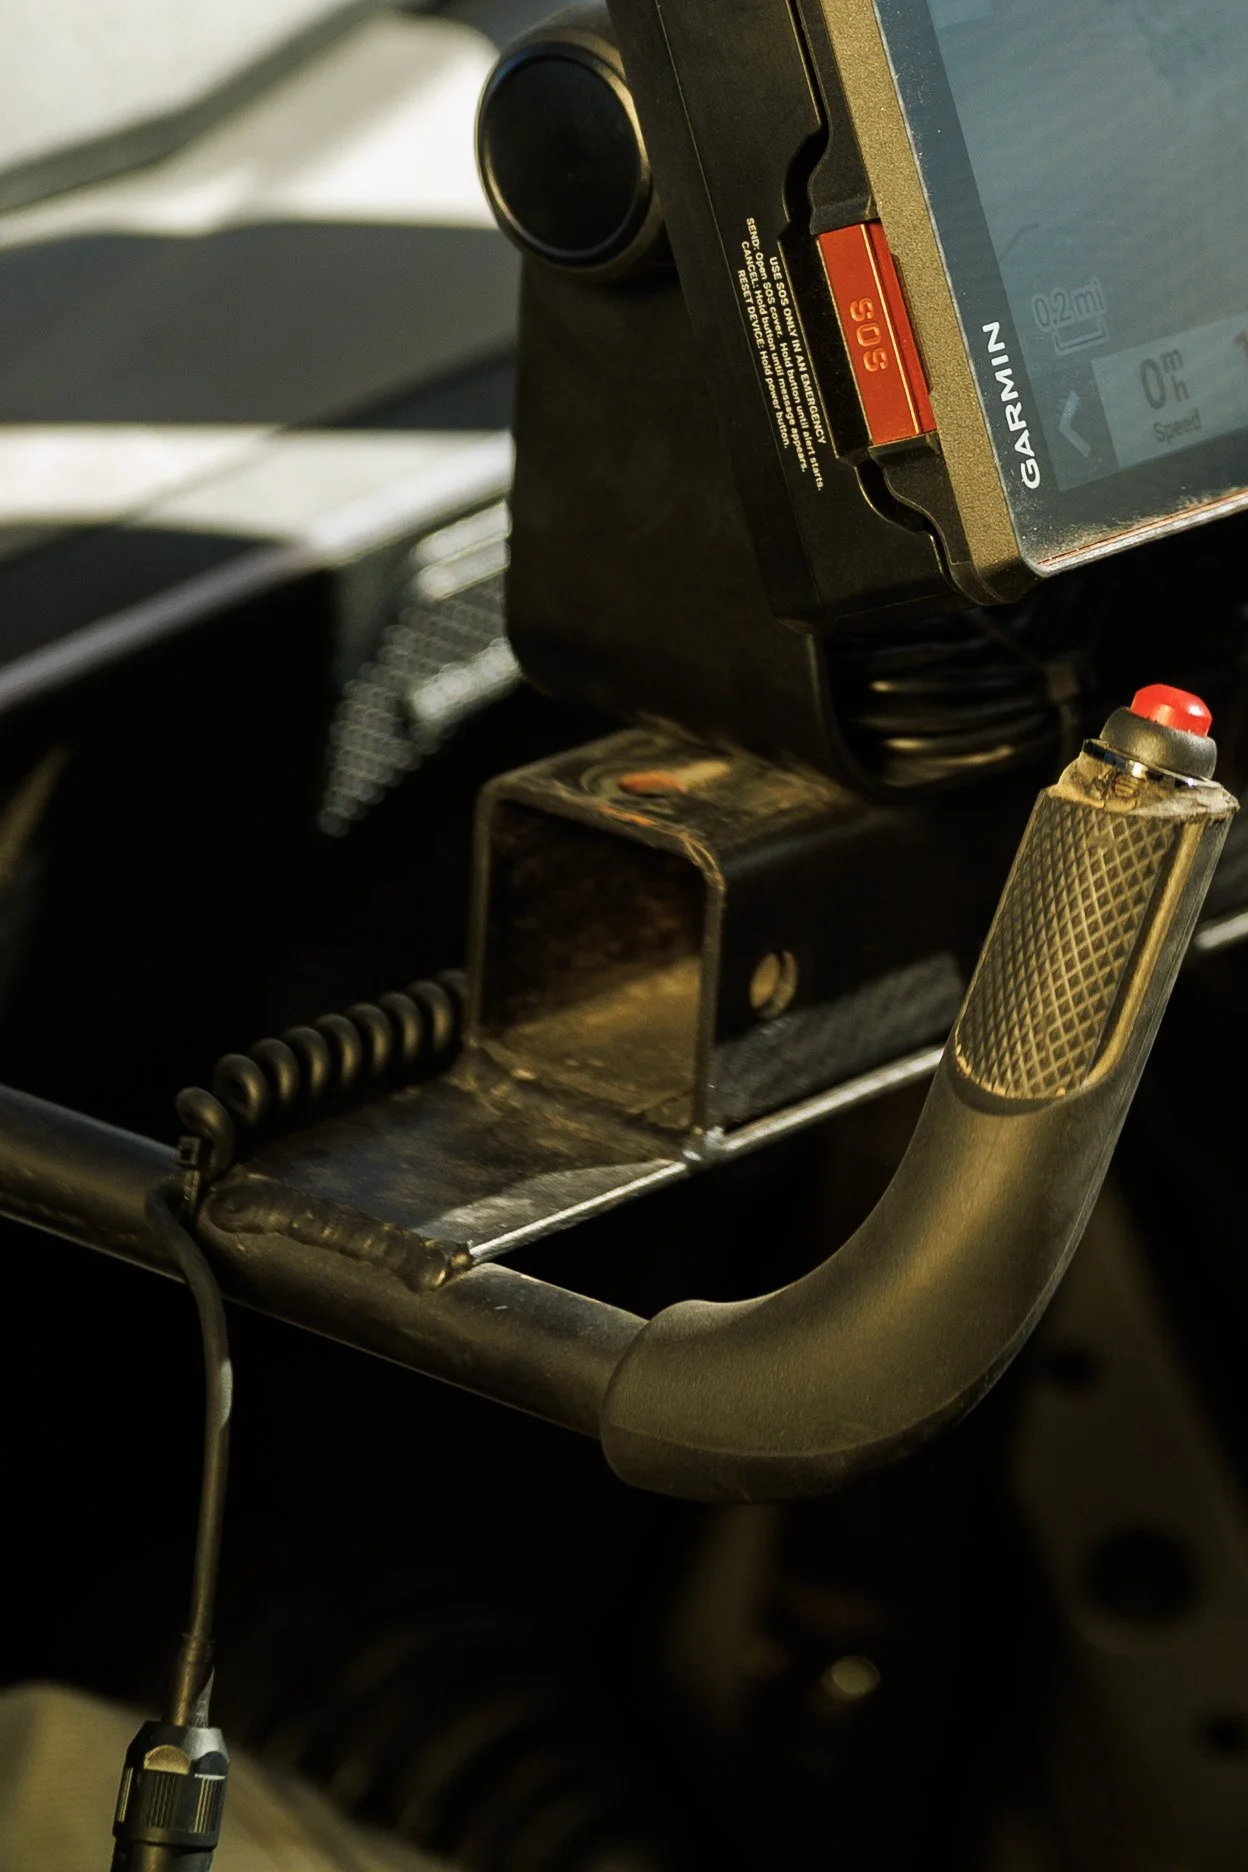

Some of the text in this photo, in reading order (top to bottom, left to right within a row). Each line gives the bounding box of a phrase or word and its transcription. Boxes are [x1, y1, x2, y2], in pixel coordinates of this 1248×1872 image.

[738, 269, 790, 449] RESET DEVICE: Hold power button.
[741, 241, 808, 473] CANCEL: Hold button until message appears.
[746, 217, 824, 491] SEND: Open SOS cover. Hold button until alert starts.
[769, 256, 827, 445] USE SOS ONLY IN AN EMERGENCY
[849, 297, 889, 372] SOS
[1033, 282, 1105, 330] 0.2 mi
[982, 321, 1041, 490] GARMIN
[1153, 407, 1203, 445] Speed
